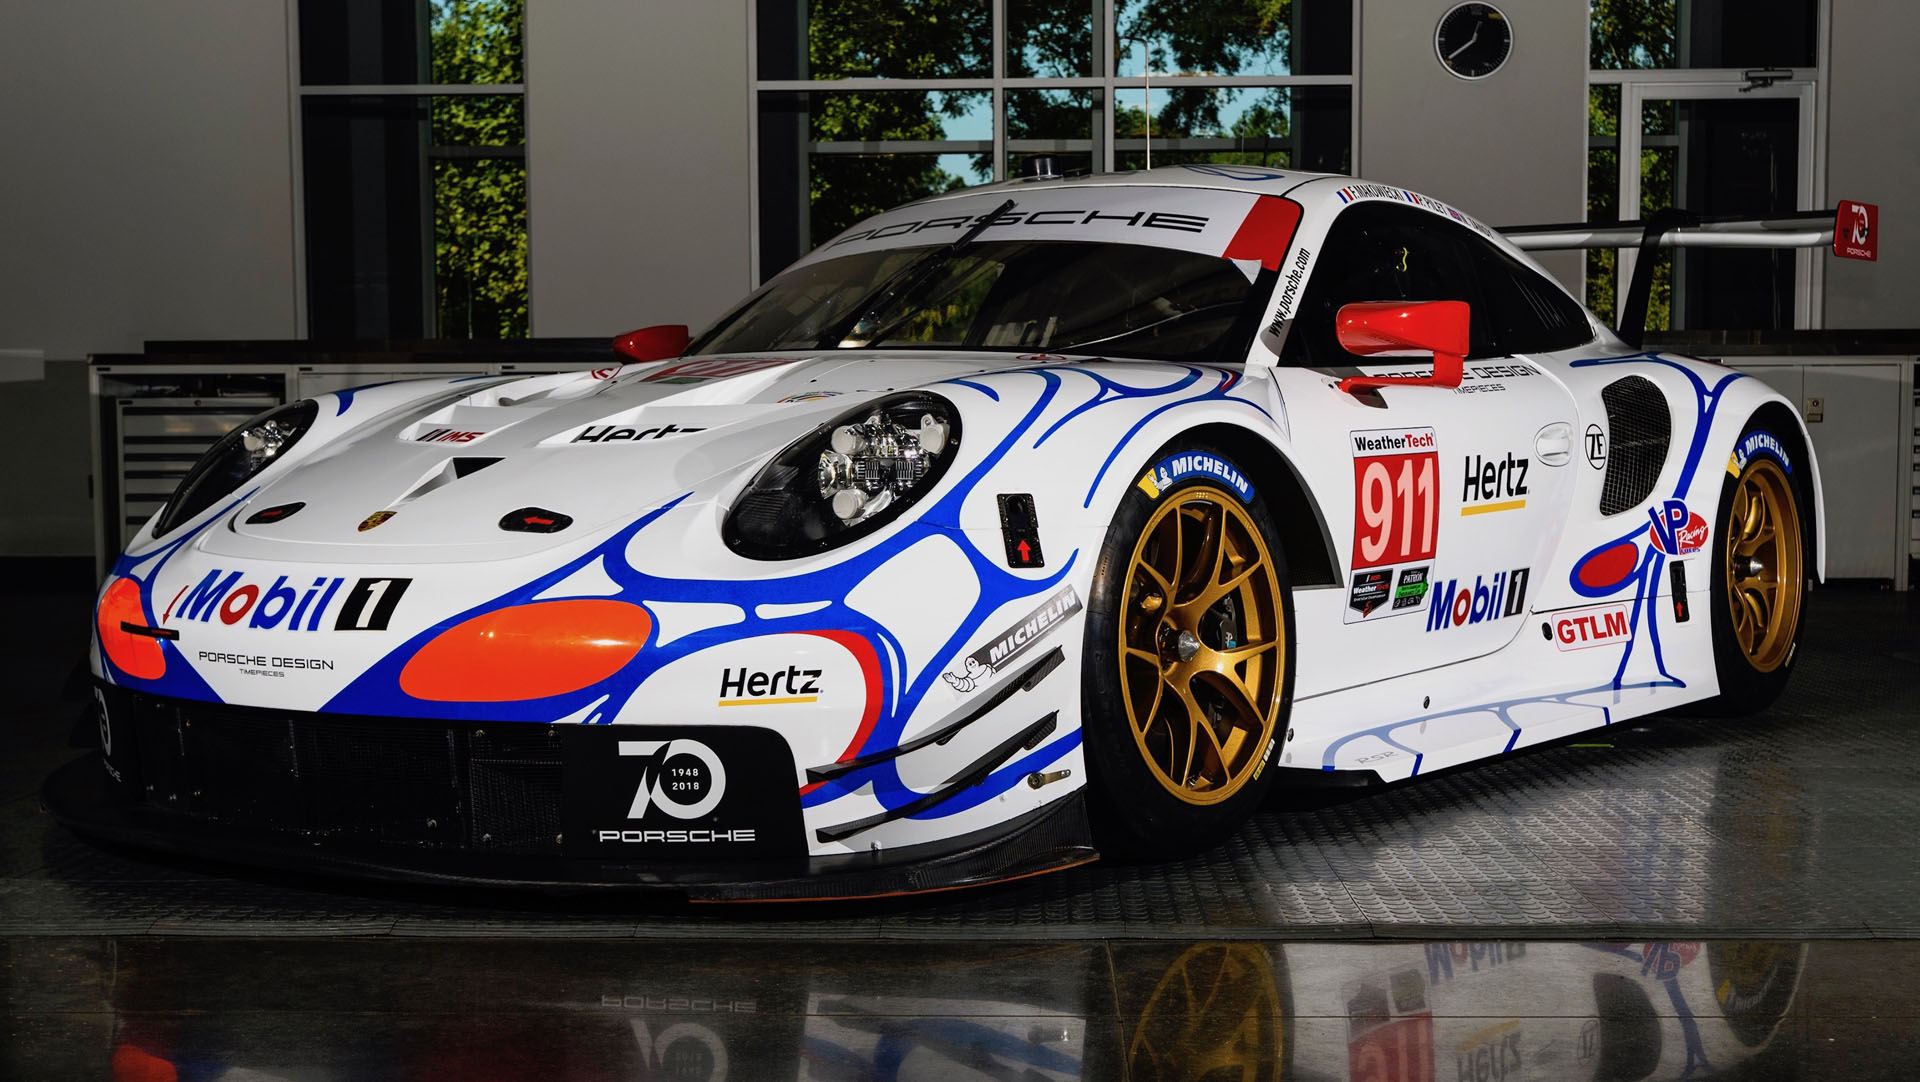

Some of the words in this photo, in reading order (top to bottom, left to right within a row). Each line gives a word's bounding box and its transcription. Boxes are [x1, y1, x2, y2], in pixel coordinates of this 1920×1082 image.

[825, 210, 1209, 251] PORSCHE
[1268, 247, 1311, 338] www.porsche.com
[1471, 364, 1541, 379] DESIGN
[1354, 432, 1434, 451] WeatherTech
[1745, 433, 1790, 467] MICHELIN
[1171, 455, 1249, 494] MICHELIN
[1462, 451, 1529, 502] Hertz
[1361, 457, 1435, 562] 911
[1648, 500, 1688, 555] VP
[174, 568, 345, 632] Mobil
[1426, 571, 1507, 633] Mobil
[988, 590, 1077, 664] MICHELIN
[1557, 611, 1628, 644] GTLM
[199, 651, 266, 667] PORSCHE
[271, 657, 334, 671] DESIGN
[720, 665, 822, 698] Hertz
[618, 738, 727, 820] 70
[671, 768, 699, 777] 1948
[672, 782, 700, 790] 2018
[599, 829, 756, 843] PORSCHE
